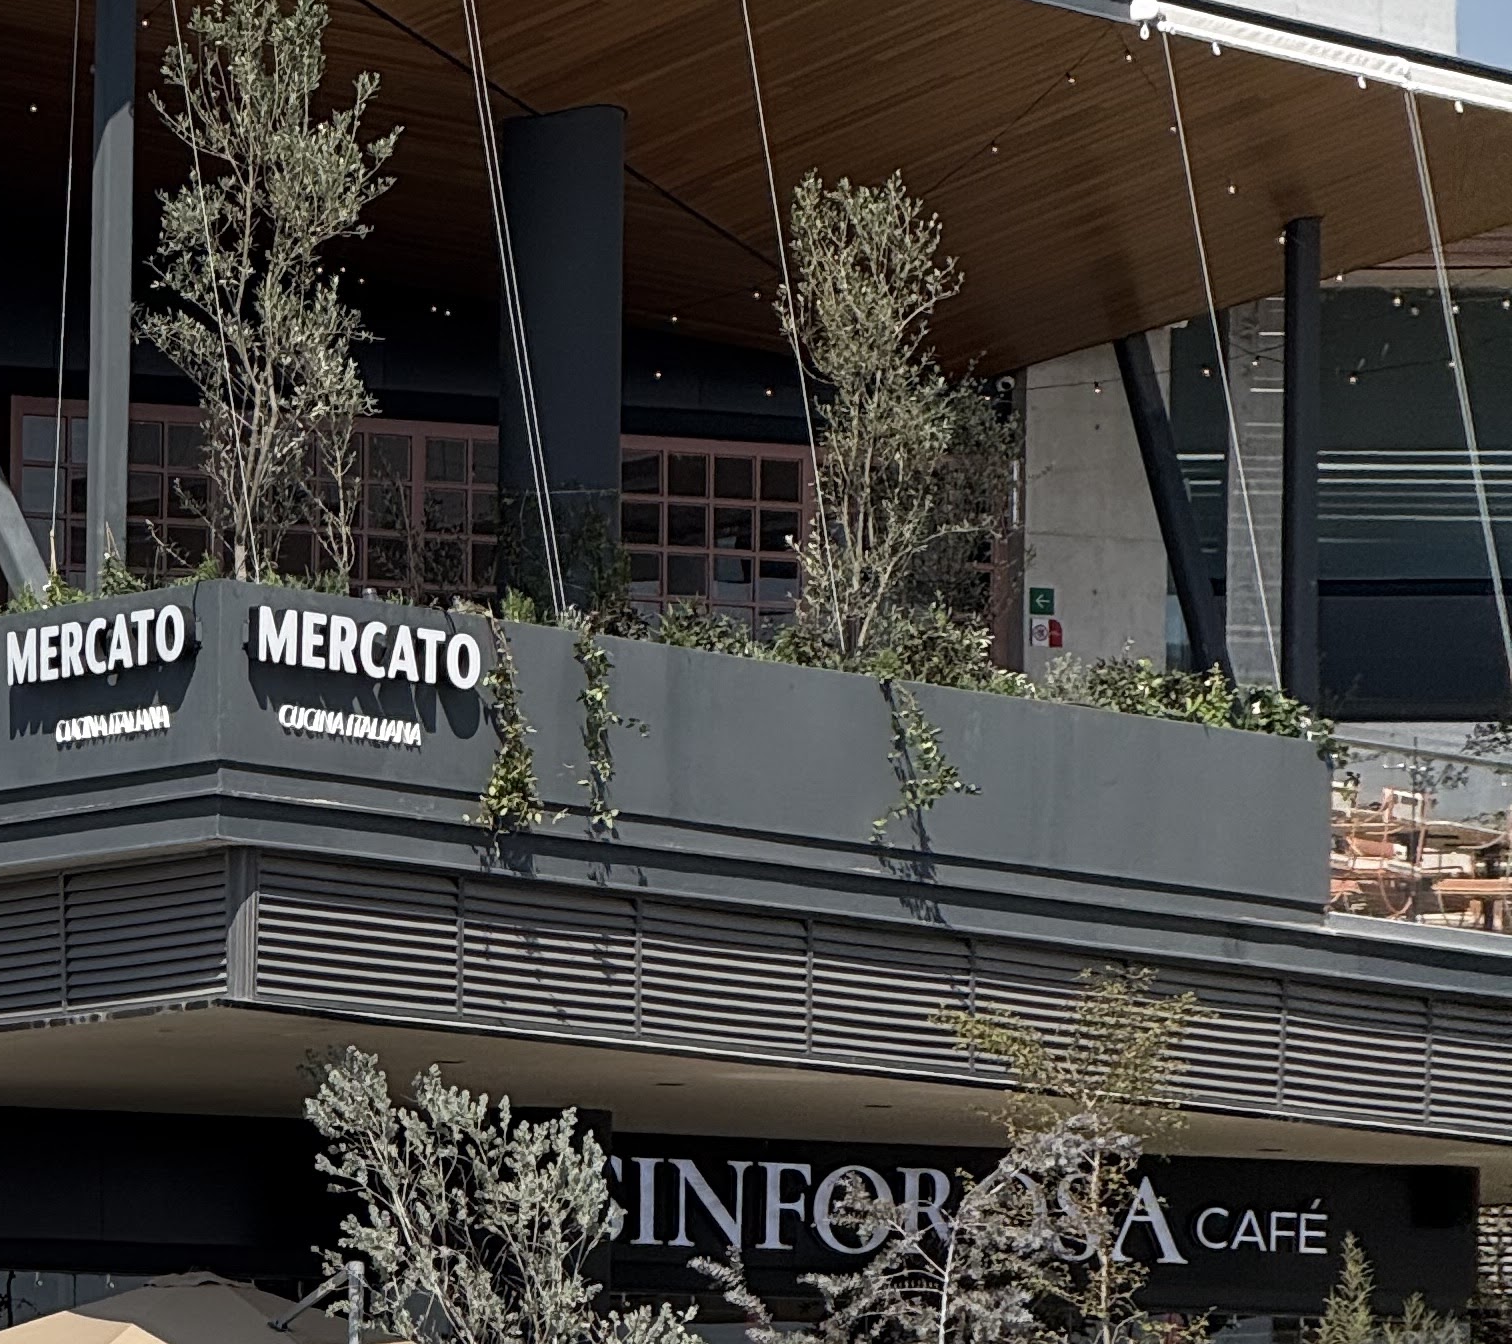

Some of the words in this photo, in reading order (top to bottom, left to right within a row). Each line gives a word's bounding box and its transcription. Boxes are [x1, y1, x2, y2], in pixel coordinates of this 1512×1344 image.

[6, 603, 186, 687] MERCATO
[257, 604, 482, 691] MERCATO
[278, 704, 345, 736] CUCINA
[345, 713, 422, 746] ITALIANA
[1195, 1197, 1329, 1255] CAFÉ
